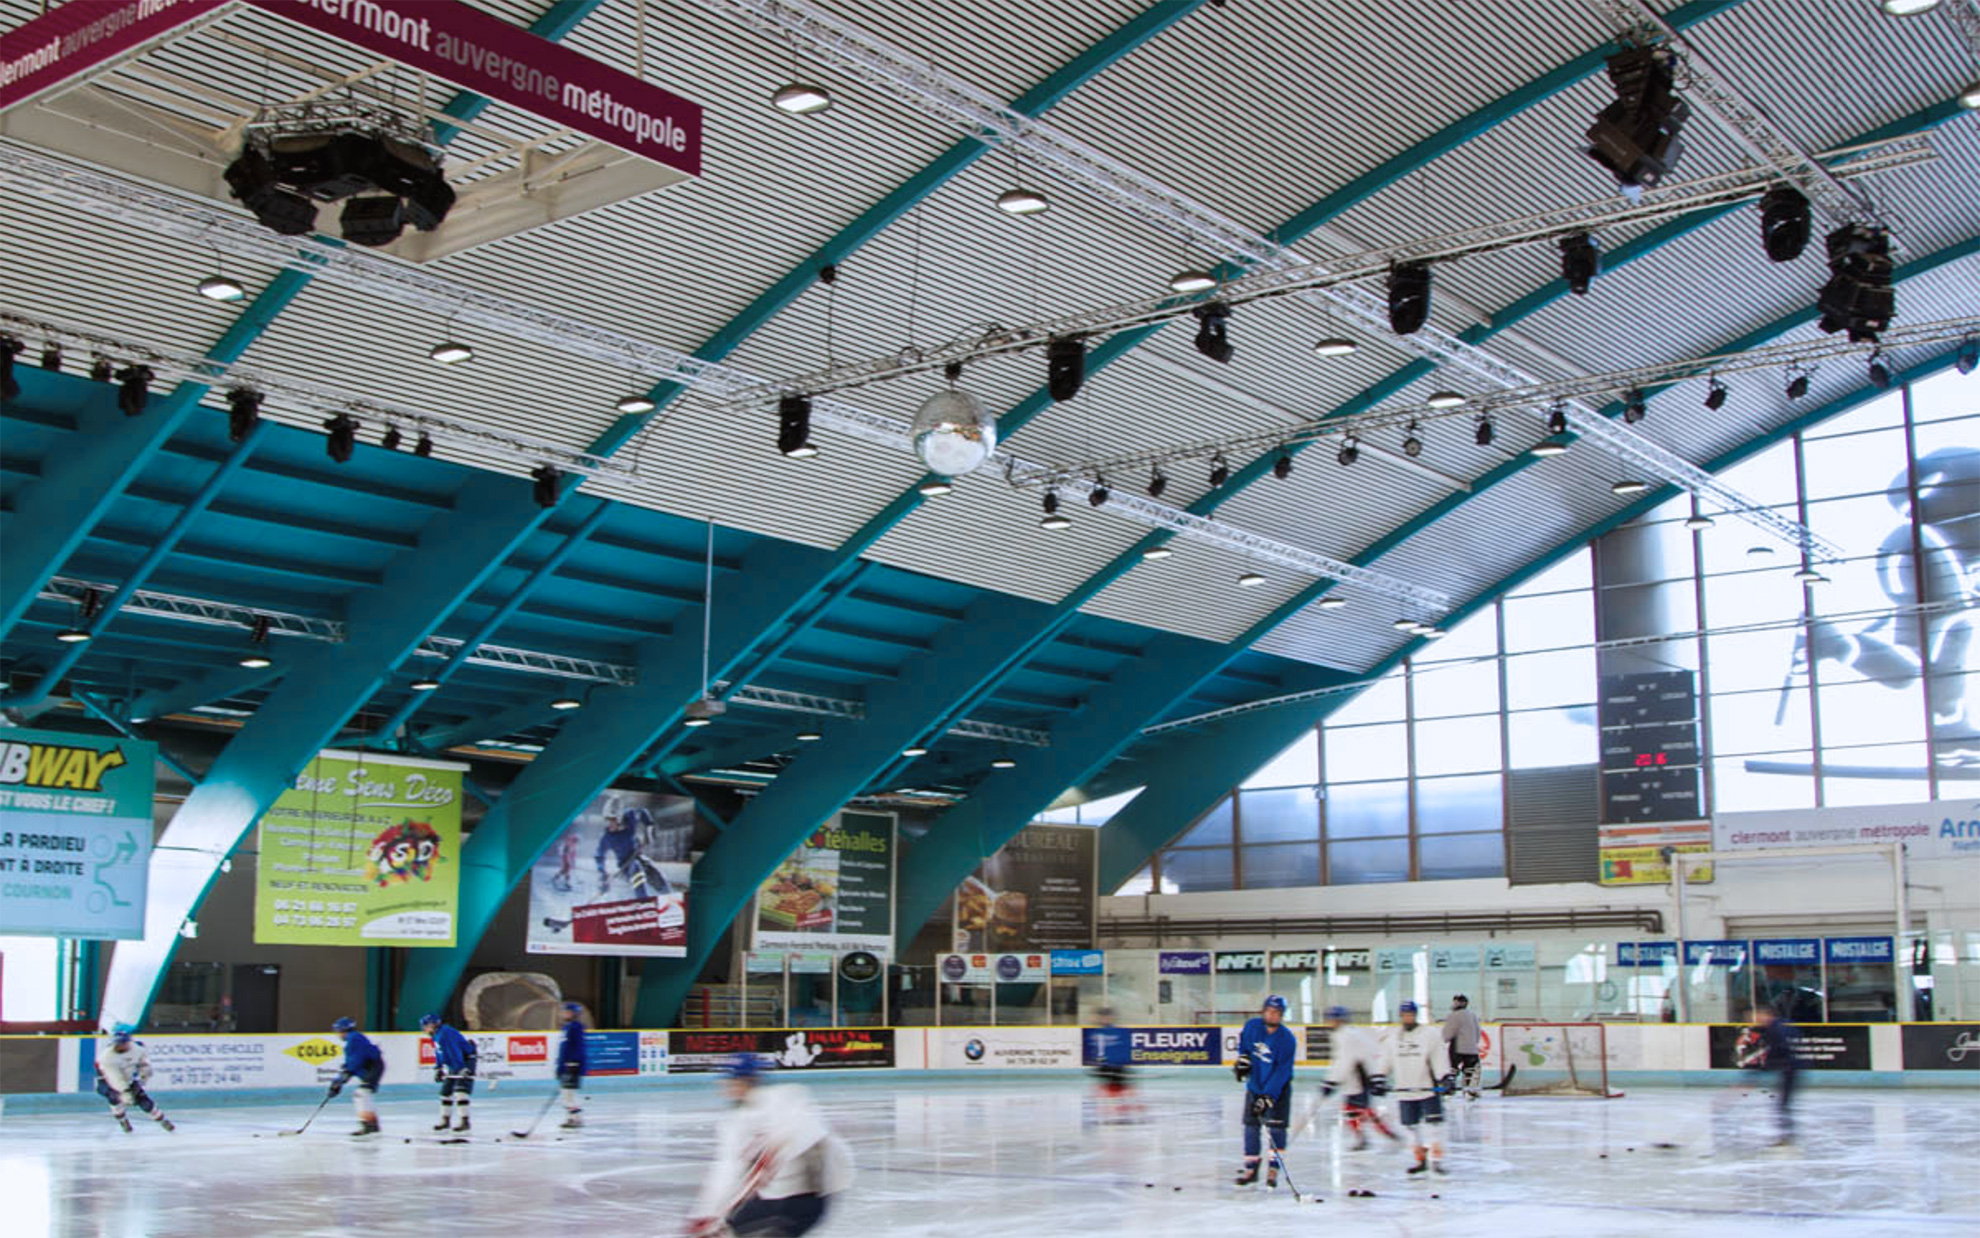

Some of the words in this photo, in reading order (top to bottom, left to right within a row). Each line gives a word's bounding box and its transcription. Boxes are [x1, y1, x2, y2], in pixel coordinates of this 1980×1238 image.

[0, 36, 60, 87] lermont
[61, 4, 137, 57] auvergne
[293, 0, 431, 52] ermont
[435, 31, 559, 101] auvergne
[563, 83, 688, 153] métropole
[344, 768, 397, 799] Sens
[405, 773, 454, 804] Déco
[53, 795, 70, 811] LE
[1731, 829, 1791, 844] clermont
[1795, 828, 1856, 842] auvergne
[1860, 821, 1930, 839] métropole
[19, 833, 86, 852] PARDIEU
[34, 859, 84, 876] DROITE
[1759, 943, 1815, 959] NOSTALGIE
[1831, 941, 1889, 957] NOSTALGIE
[686, 1035, 757, 1051] NISSAN
[1131, 1033, 1207, 1047] FLEURY
[297, 1045, 337, 1057] COLAS
[1131, 1050, 1209, 1063] Enseignes
